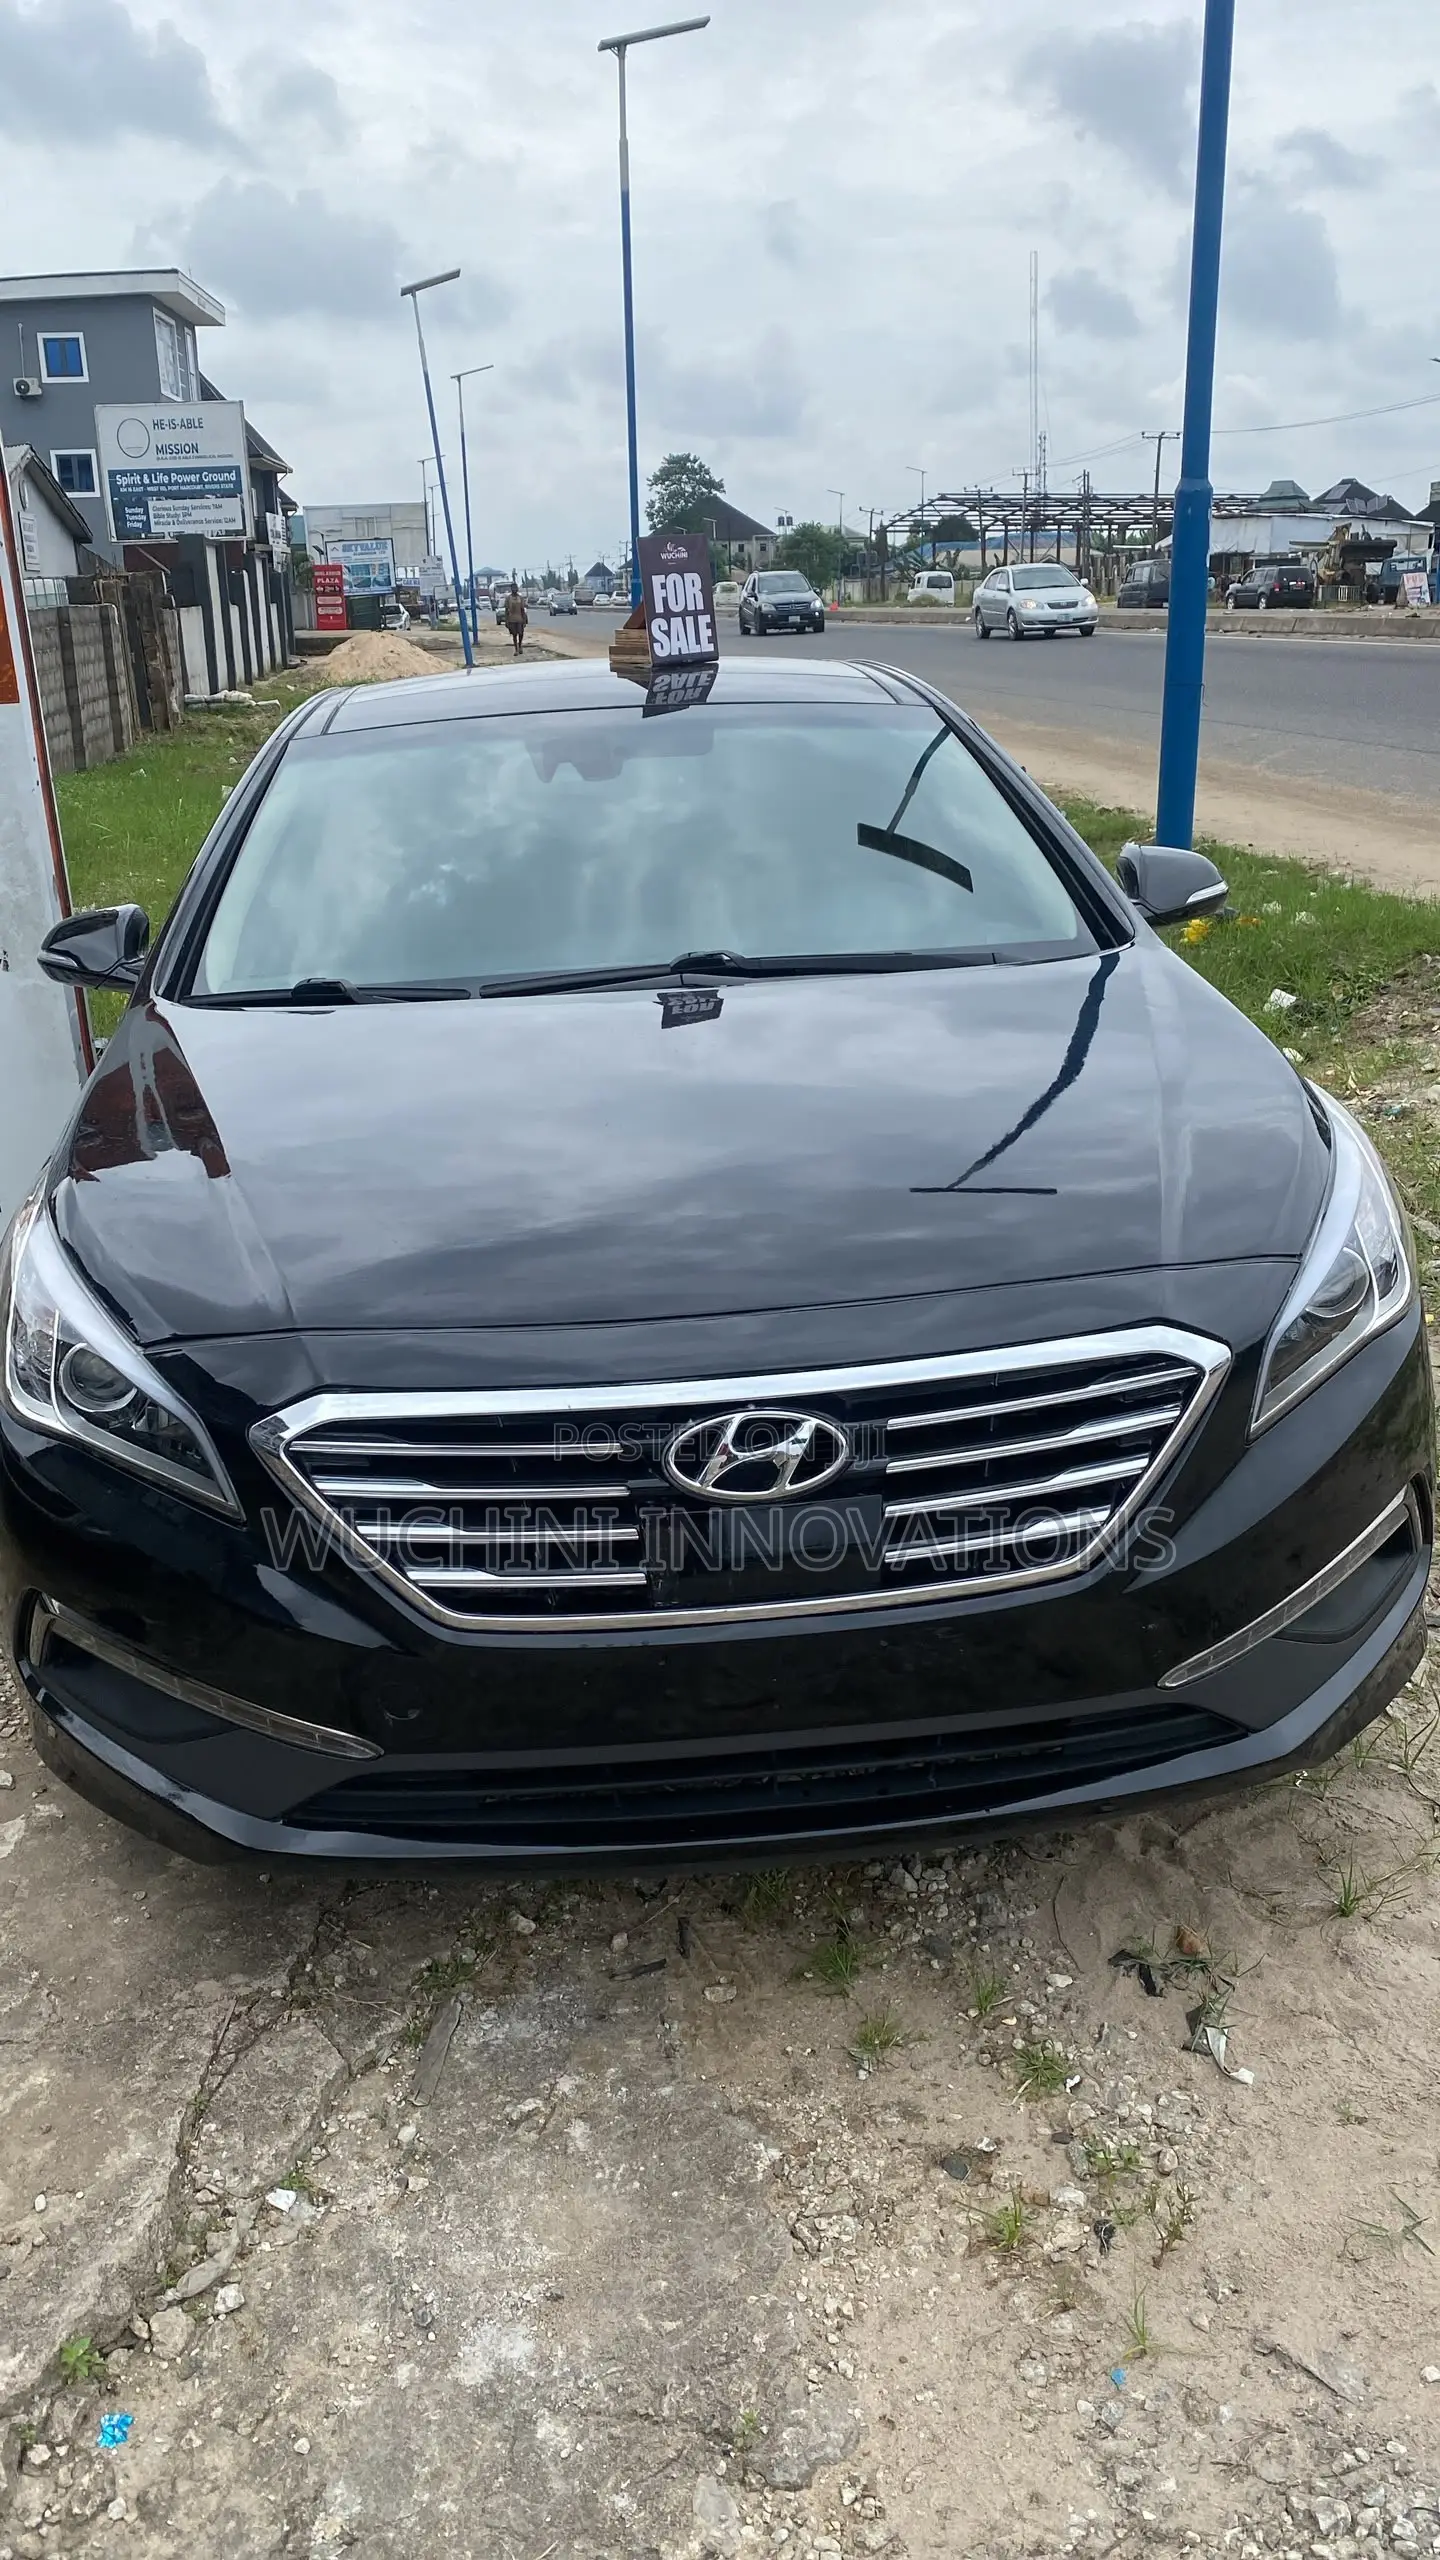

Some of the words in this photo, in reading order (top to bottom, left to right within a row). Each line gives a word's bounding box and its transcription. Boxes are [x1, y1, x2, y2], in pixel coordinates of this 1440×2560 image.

[152, 417, 204, 430] HE-IS-ABLE
[155, 443, 199, 455] MISSION
[116, 472, 141, 487] Spirit
[143, 473, 150, 484] &
[152, 472, 169, 484] Life
[171, 472, 200, 483] Power
[202, 469, 236, 482] Ground
[125, 506, 144, 514] Sunday
[126, 514, 147, 522] Tuesday
[127, 521, 142, 529] Friday
[660, 551, 688, 560] WUCHINI
[652, 572, 704, 614] FOR
[651, 614, 714, 657] SALE
